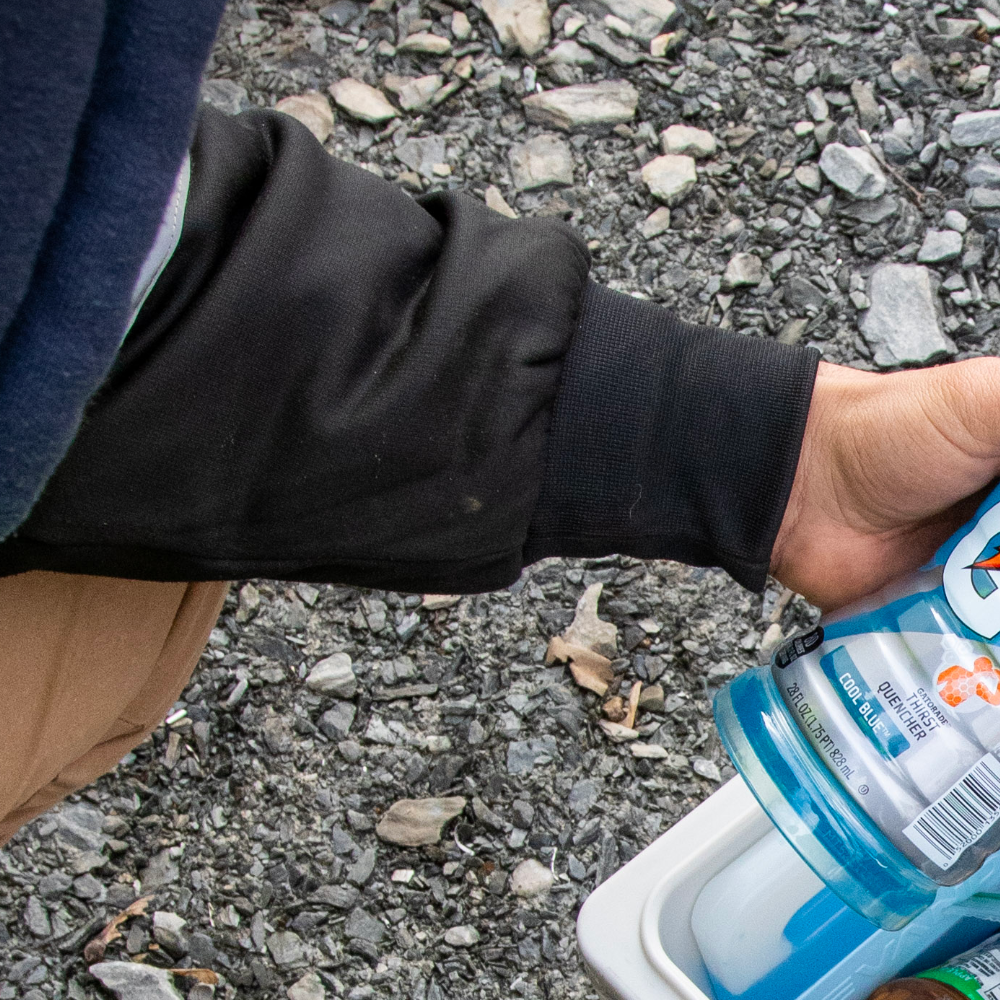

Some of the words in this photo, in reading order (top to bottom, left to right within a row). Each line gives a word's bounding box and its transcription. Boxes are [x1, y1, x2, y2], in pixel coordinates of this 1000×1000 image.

[787, 682, 799, 696] 28
[838, 672, 864, 705] COOL
[791, 692, 804, 707] FL
[797, 704, 811, 718] OZ
[877, 681, 927, 742] QUENCHER
[905, 693, 940, 733] THIRST
[804, 714, 826, 742] (1.75
[819, 736, 836, 753] PT)
[829, 748, 848, 768] 828
[841, 764, 856, 780] mL
